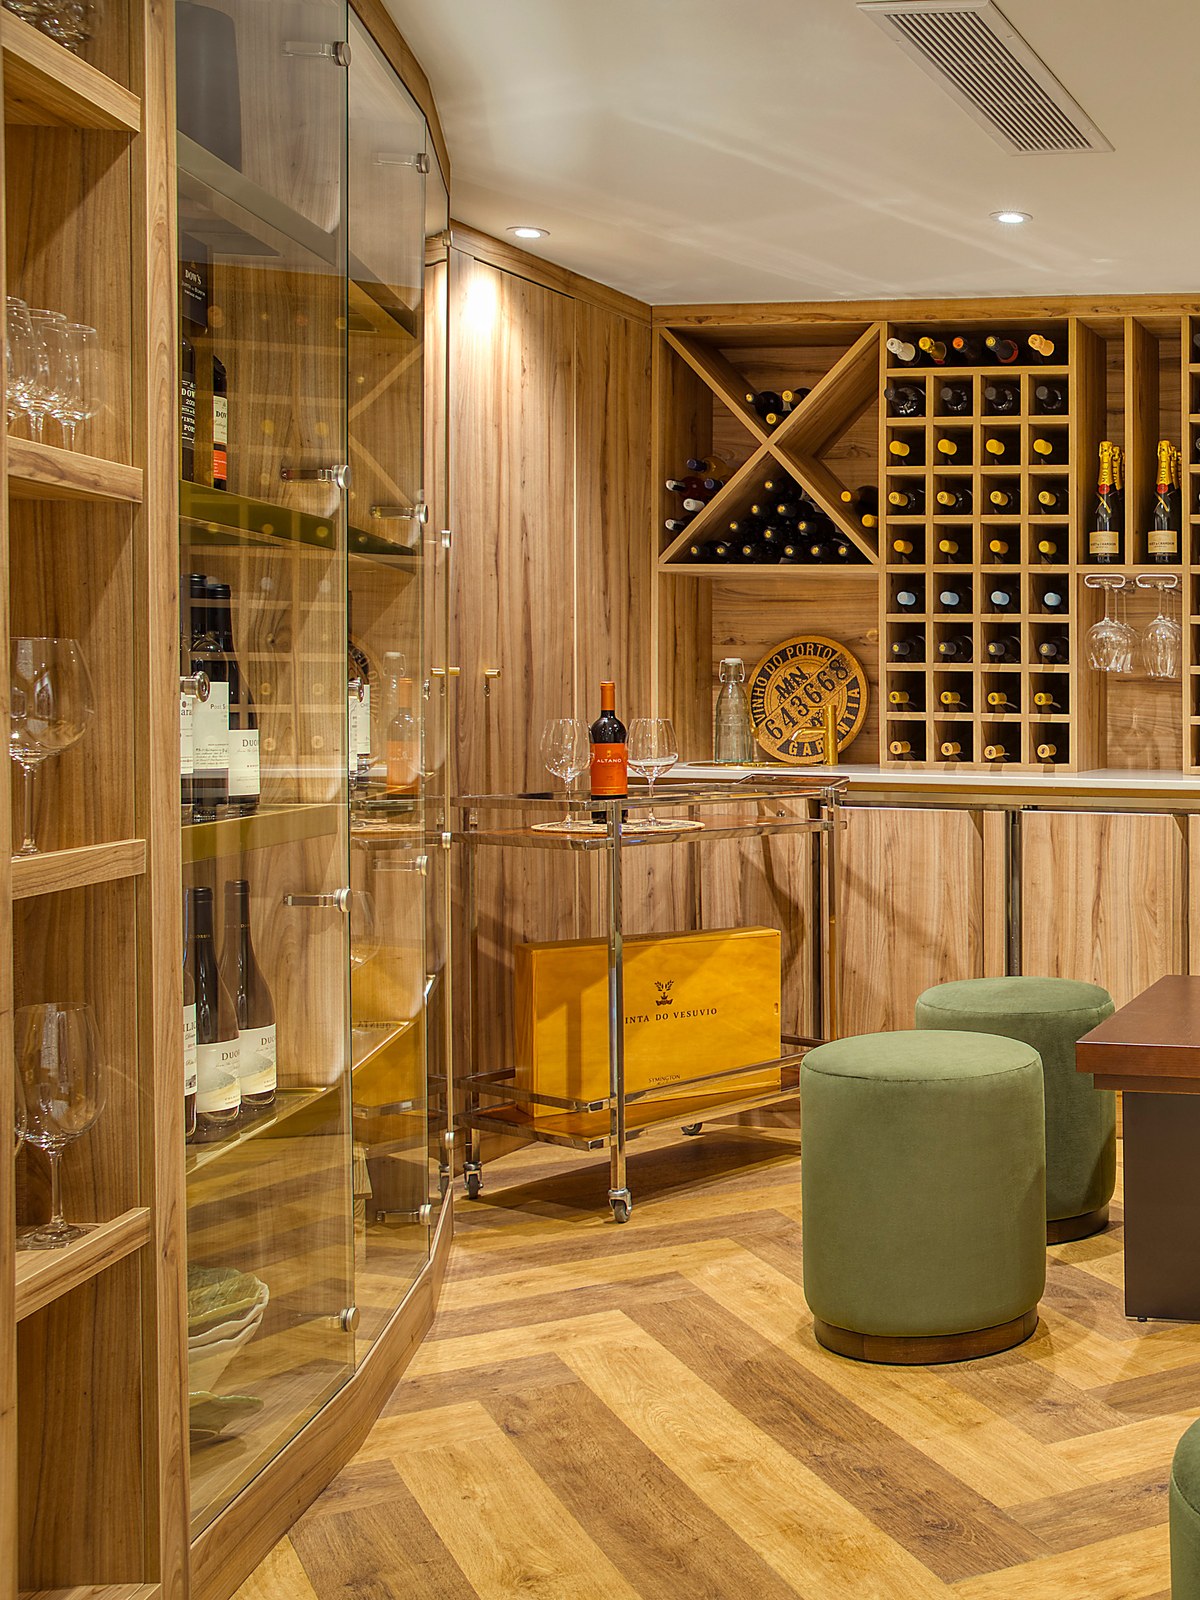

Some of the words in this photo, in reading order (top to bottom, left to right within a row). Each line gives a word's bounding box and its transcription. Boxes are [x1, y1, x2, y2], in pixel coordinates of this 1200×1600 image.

[751, 676, 768, 723] VINHO
[766, 654, 784, 674] DO
[786, 643, 833, 660] PORTO
[764, 659, 849, 740] 643668
[774, 666, 809, 699] MN
[788, 688, 861, 756] GARNTIA
[655, 1013, 669, 1021] DO
[673, 1007, 718, 1019] VESUVIO
